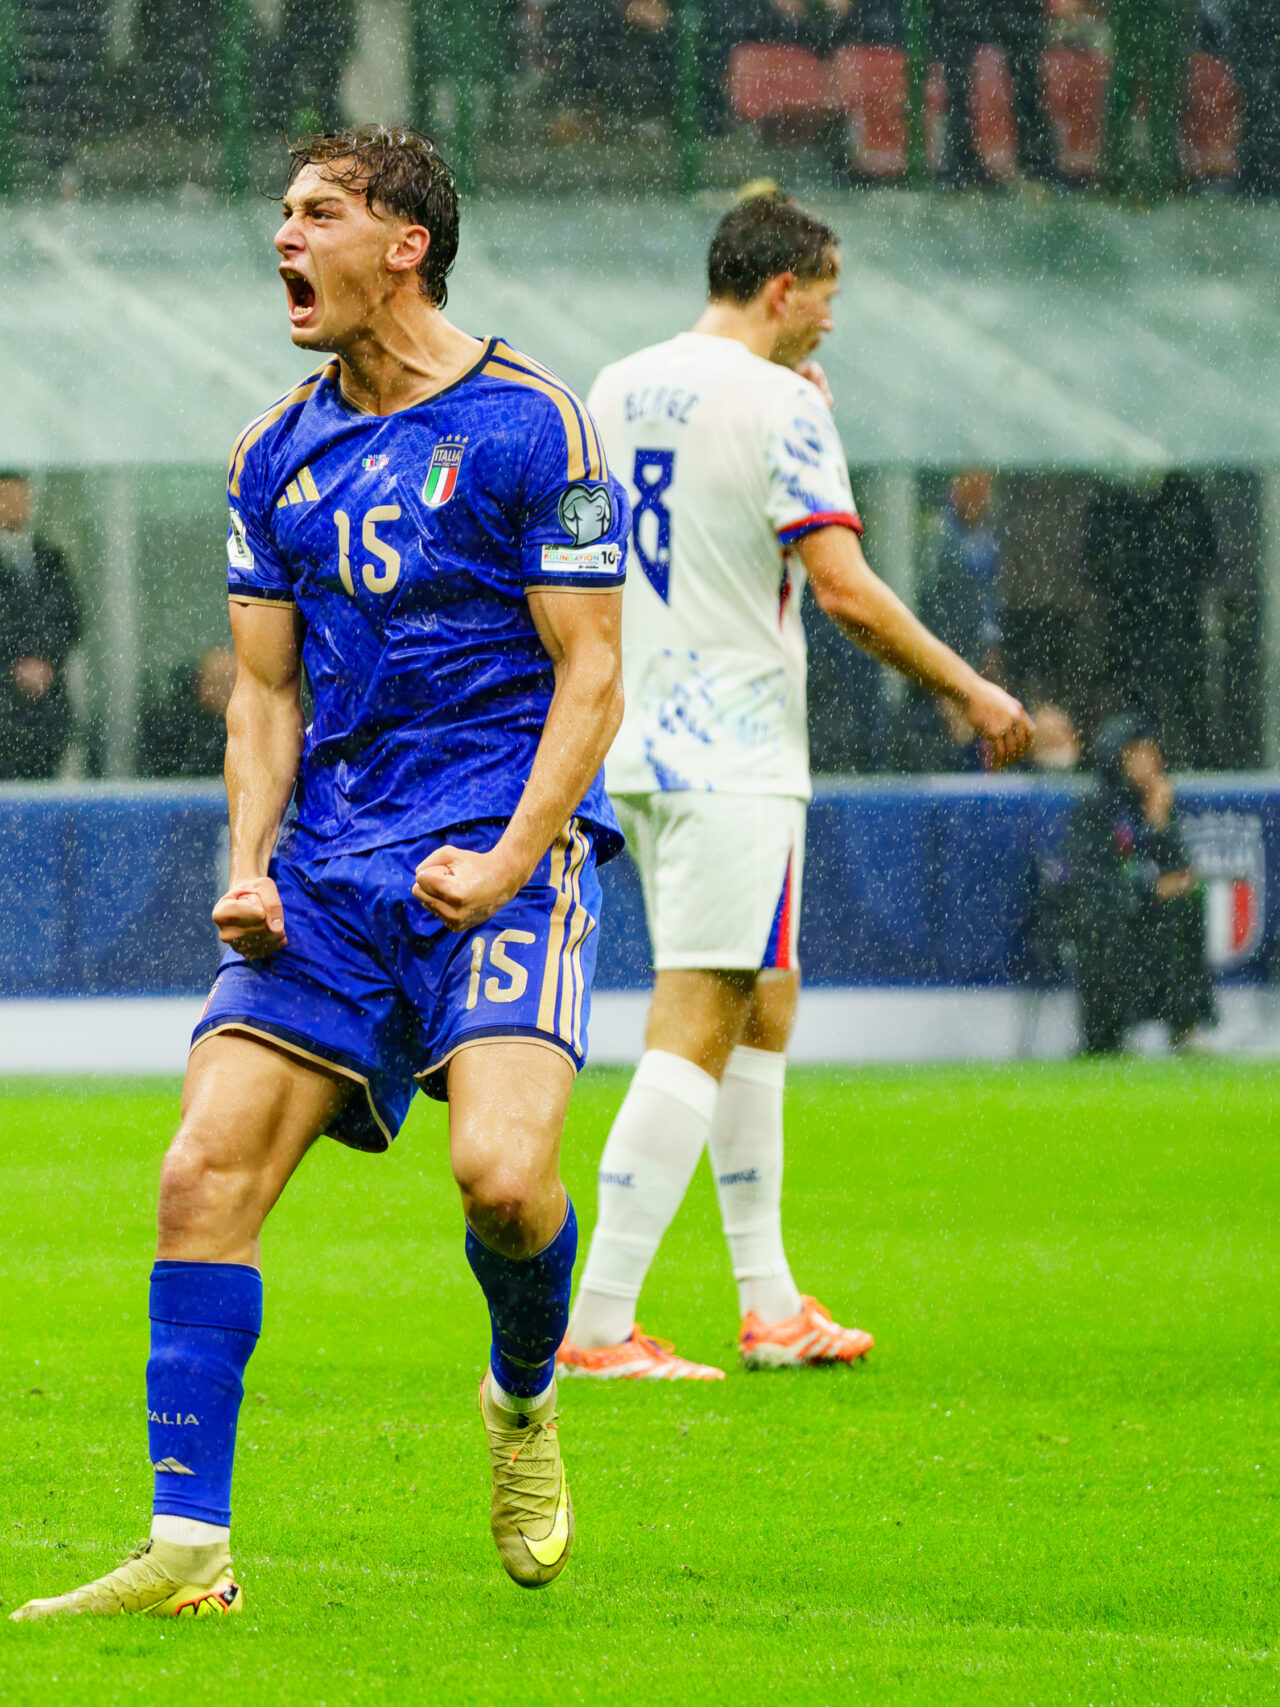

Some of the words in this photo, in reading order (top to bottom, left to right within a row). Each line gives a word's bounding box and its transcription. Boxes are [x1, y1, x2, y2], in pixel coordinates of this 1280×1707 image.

[434, 449, 461, 462] ITALIA
[333, 505, 402, 596] 15
[601, 550, 616, 565] 10
[631, 447, 676, 608] 8
[466, 929, 536, 1010] 15
